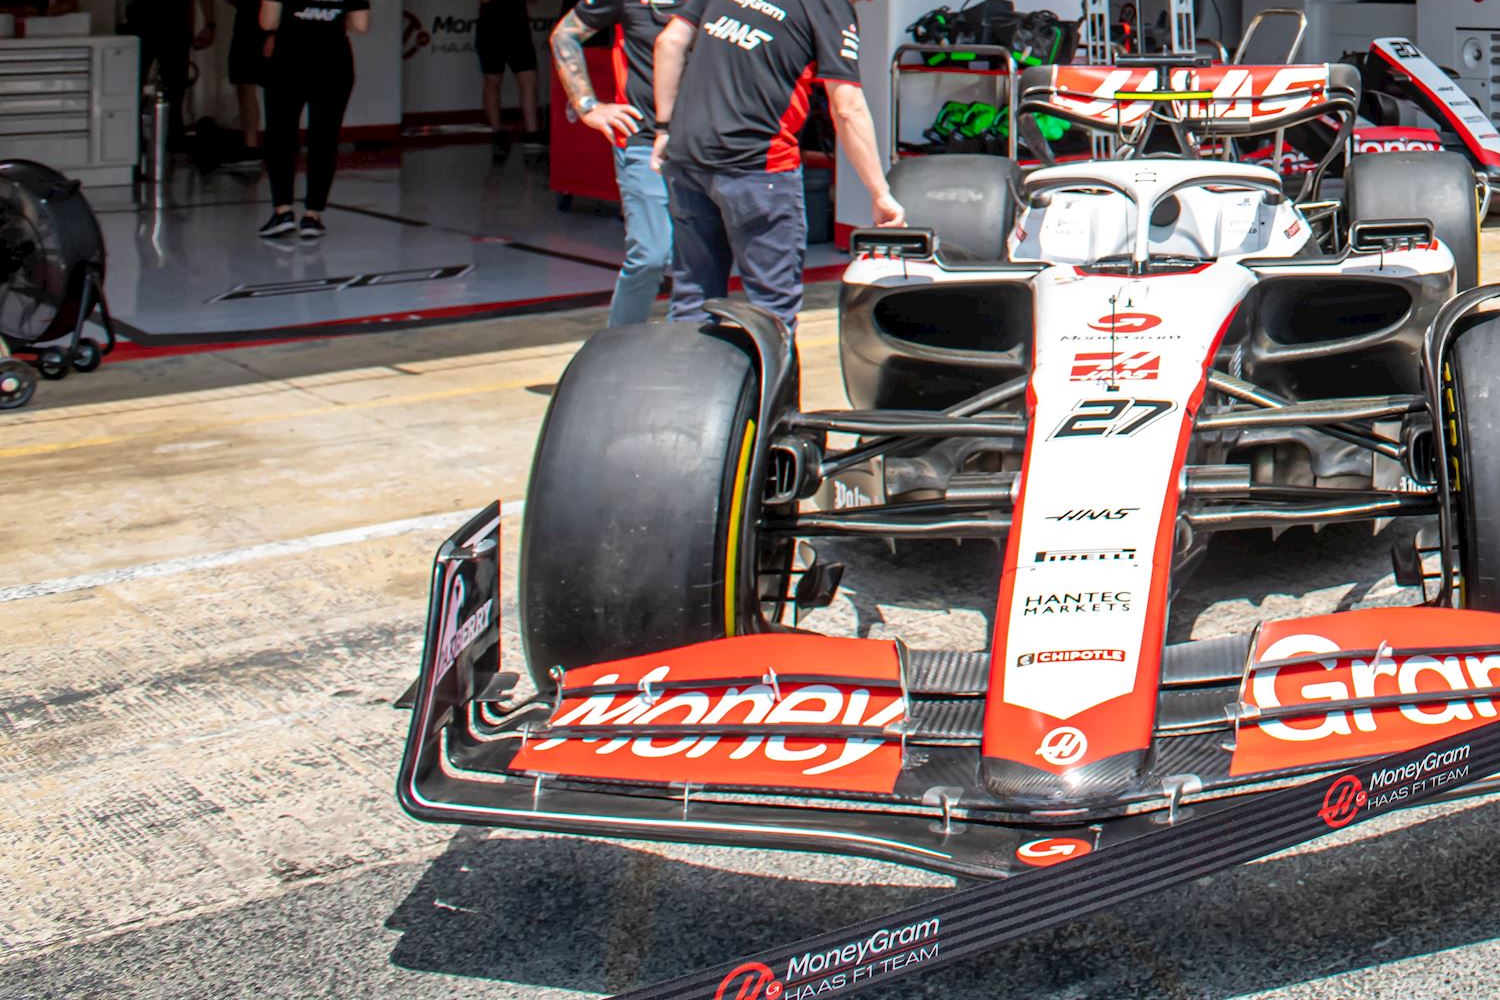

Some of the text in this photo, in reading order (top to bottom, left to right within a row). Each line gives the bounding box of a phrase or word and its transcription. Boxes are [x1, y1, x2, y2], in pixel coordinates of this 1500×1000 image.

[1045, 397, 1179, 443] 27
[1034, 548, 1137, 563] PIRELLI
[1023, 602, 1131, 616] MARKETS
[1026, 592, 1132, 607] HANTEC
[1038, 650, 1123, 663] CHIPOTLE
[533, 665, 905, 776] Money
[1367, 765, 1469, 810] HAAS F1 TEAM
[1369, 744, 1471, 791] MoneyGram
[784, 943, 940, 1000] HAAS F1 TEAM
[786, 917, 941, 982] MoneyGram
